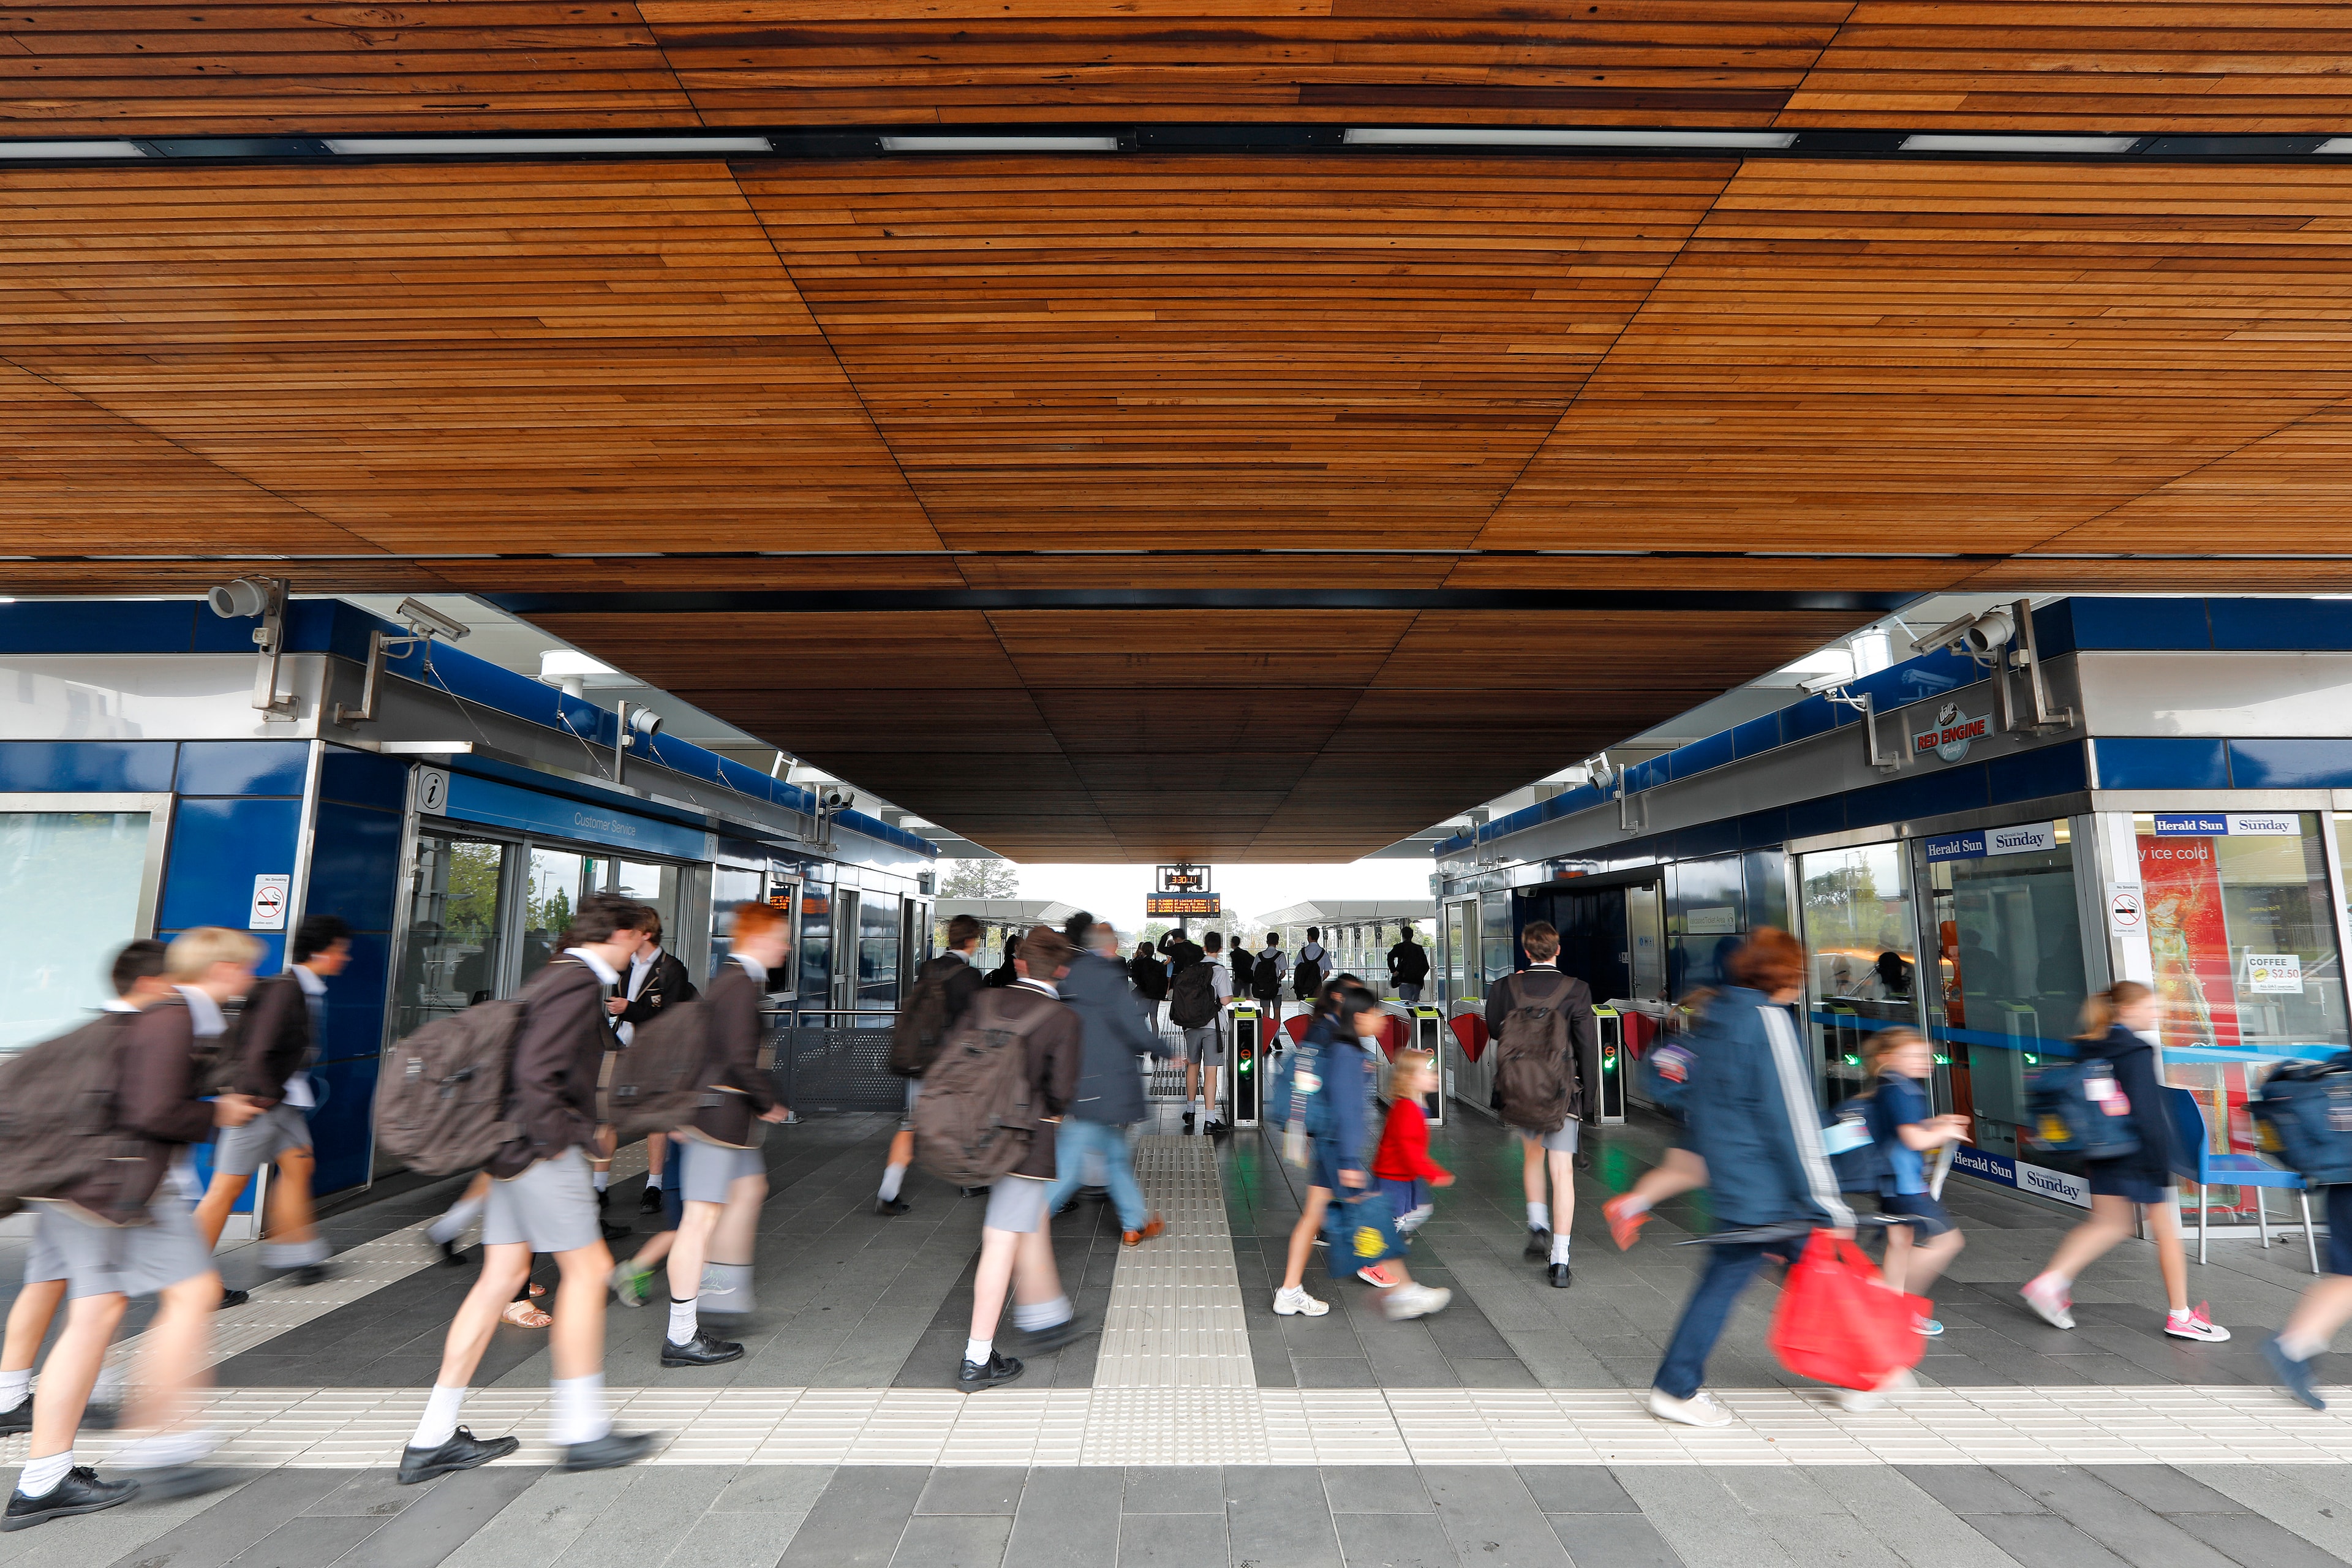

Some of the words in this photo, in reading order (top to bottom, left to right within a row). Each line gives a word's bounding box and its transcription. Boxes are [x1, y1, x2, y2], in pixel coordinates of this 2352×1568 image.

[1918, 733, 1939, 750] RED
[1942, 719, 1985, 744] ENGINE
[1943, 743, 1961, 759] Group
[575, 812, 610, 831] Customer
[611, 820, 636, 836] Service
[2157, 821, 2197, 831] Herald
[2199, 821, 2224, 831] Sun
[2239, 820, 2290, 832] Sunday
[1928, 840, 1961, 856] Herald
[1962, 840, 1983, 852] Sun
[1996, 832, 2045, 848] Sunday
[2150, 846, 2173, 859] ice
[2176, 846, 2208, 859] cold
[2272, 968, 2299, 979] $2.50
[1954, 1151, 1989, 1172] Herald
[1991, 1161, 2013, 1179] Sun
[2027, 1170, 2080, 1200] Sunday
